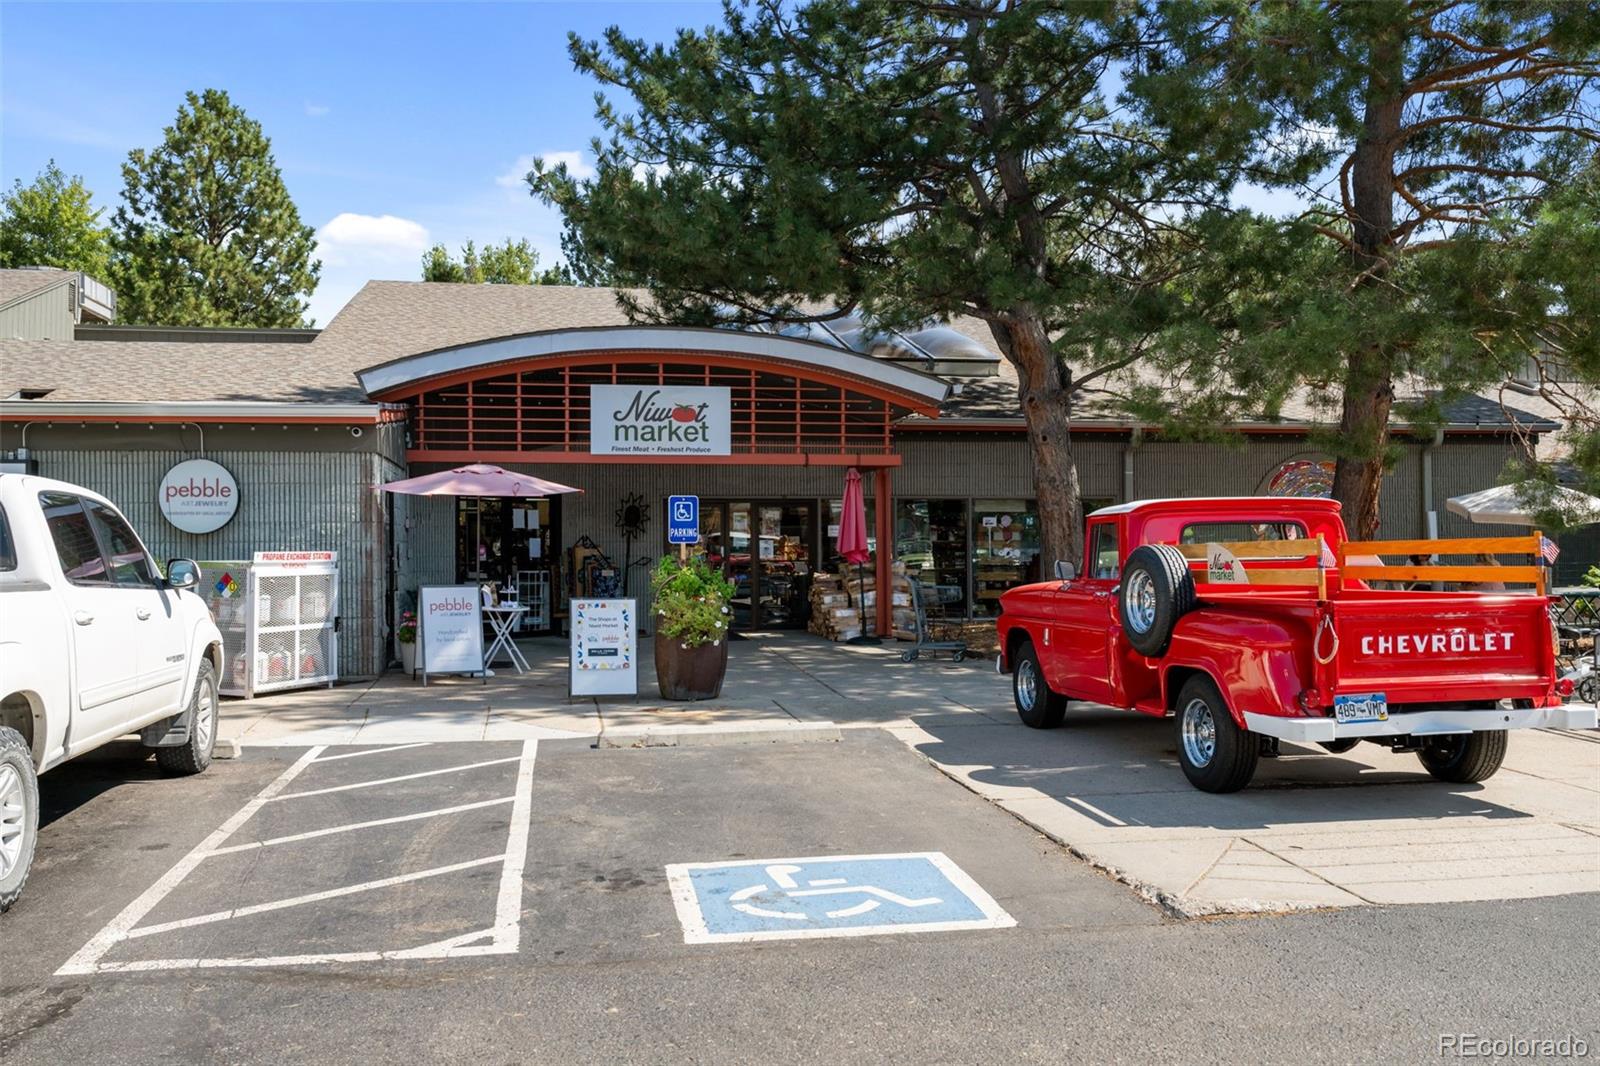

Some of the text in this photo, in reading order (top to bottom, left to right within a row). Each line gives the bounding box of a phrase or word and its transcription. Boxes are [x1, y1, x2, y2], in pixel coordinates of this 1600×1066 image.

[614, 420, 710, 442] market
[611, 445, 631, 453] Finest
[166, 477, 232, 503] pebble
[670, 527, 697, 538] PARKING
[262, 552, 332, 561] PROPANE EXCHANGE STATION
[1210, 570, 1235, 581] market
[430, 596, 473, 615] pebble
[1361, 632, 1515, 655] CHEVROLET
